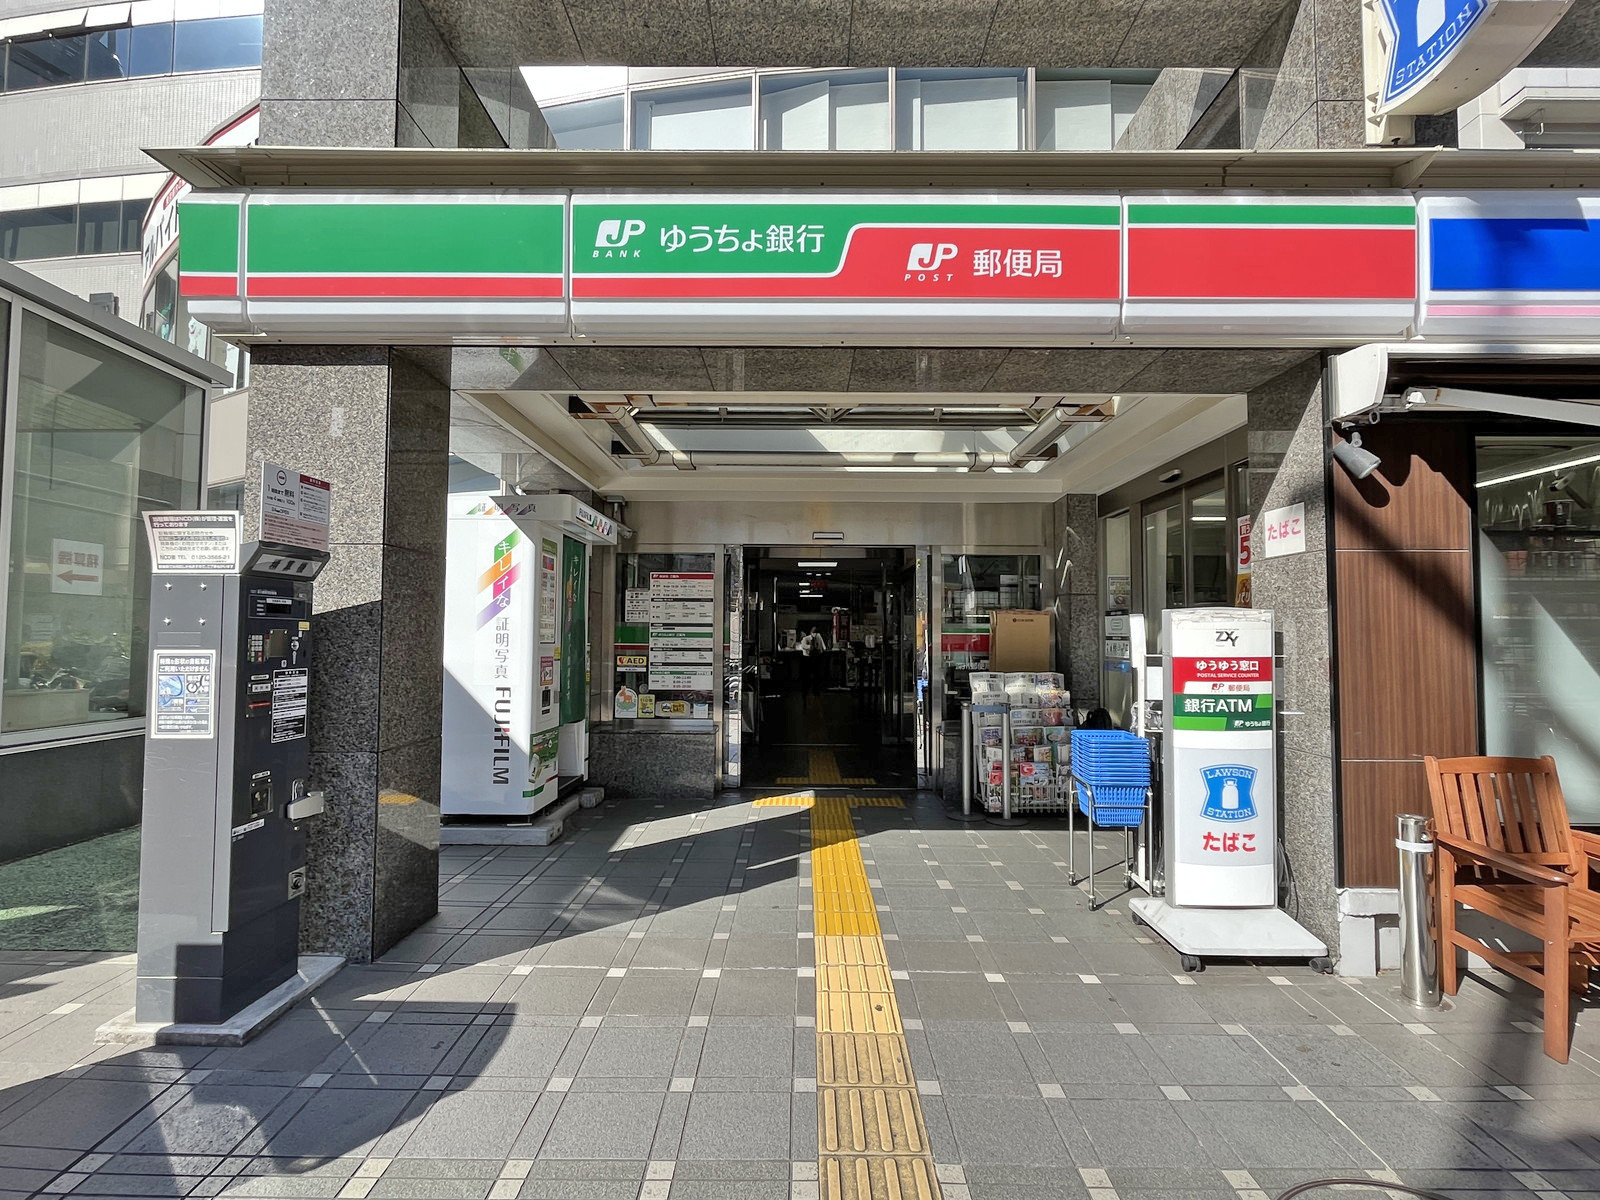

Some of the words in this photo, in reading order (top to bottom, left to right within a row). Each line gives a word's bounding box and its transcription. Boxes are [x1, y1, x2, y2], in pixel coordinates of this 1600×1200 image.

[1394, 2, 1473, 86] STATION
[660, 223, 826, 253] ゆうちょ銀行
[592, 249, 641, 259] BANK
[973, 248, 1063, 278] 郵便局
[904, 273, 954, 282] POST
[1267, 517, 1302, 541] たばこ
[496, 540, 512, 608] キレイな
[1215, 631, 1240, 647] ZXY
[494, 616, 510, 680] 証明写真
[626, 657, 645, 665] AED
[1195, 660, 1260, 671] ゆうゆう窓口
[1228, 684, 1251, 692] 郵便局
[1184, 698, 1253, 713] 銀行ATM
[1245, 719, 1271, 727] ゆうちょ銀行
[493, 686, 511, 785] FUJIFILM
[1205, 768, 1253, 780] LAWSON
[1206, 807, 1252, 819] STATION
[1202, 831, 1256, 853] たばこ
